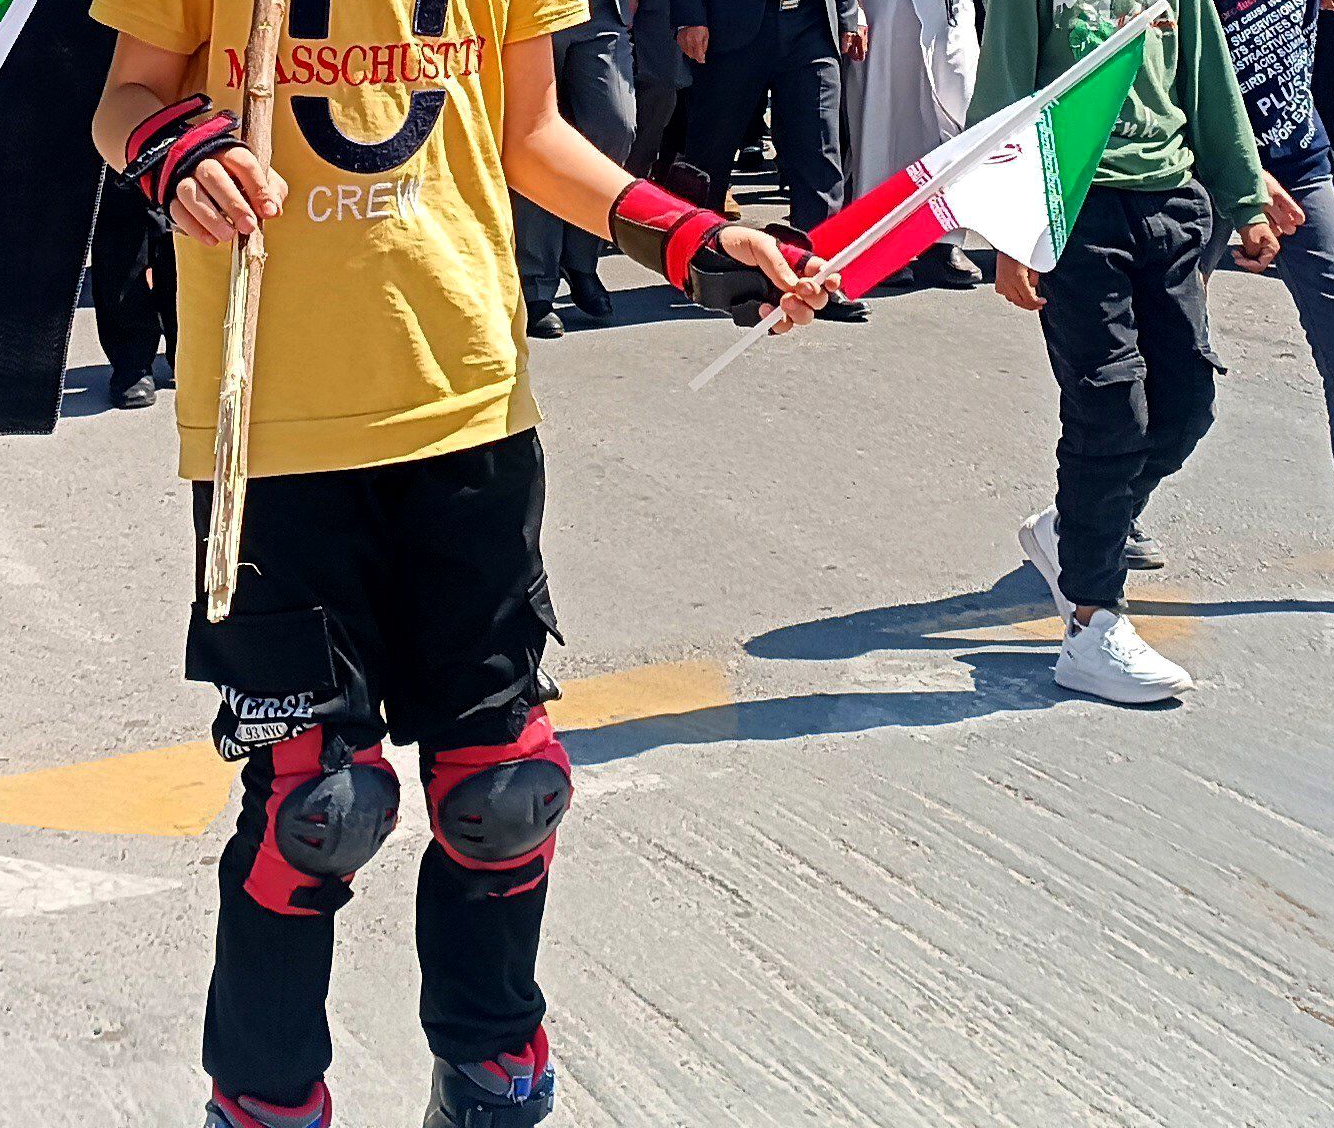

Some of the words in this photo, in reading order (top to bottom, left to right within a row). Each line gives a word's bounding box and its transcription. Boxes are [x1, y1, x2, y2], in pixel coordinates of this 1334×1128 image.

[1240, 73, 1267, 94] EIRD
[307, 174, 424, 222] CREW
[261, 723, 284, 739] NYC
